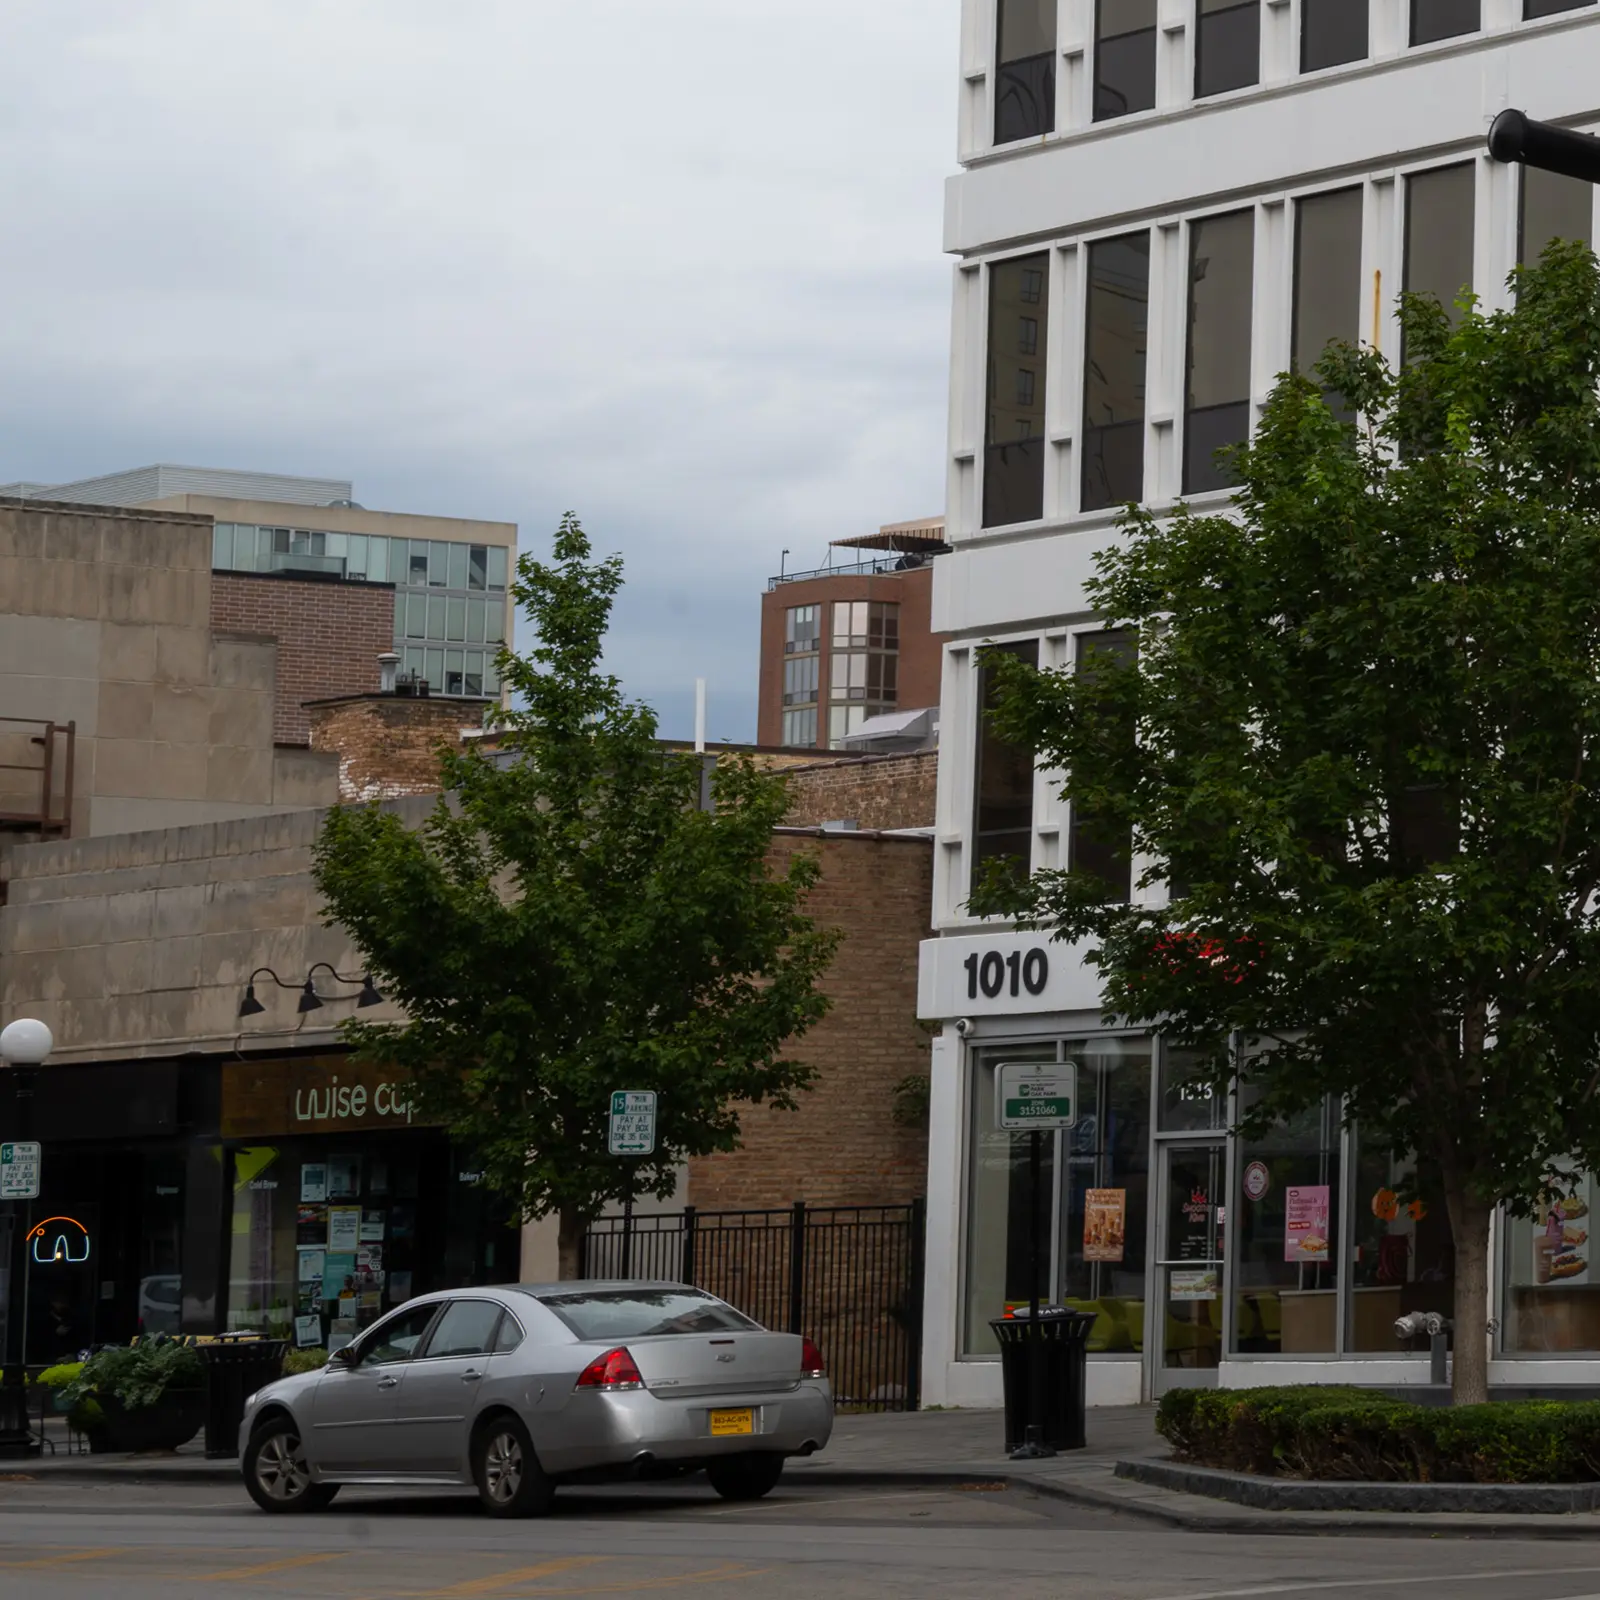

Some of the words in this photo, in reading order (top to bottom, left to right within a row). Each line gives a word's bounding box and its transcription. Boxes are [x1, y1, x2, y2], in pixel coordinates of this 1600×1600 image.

[964, 948, 1049, 999] 1010
[614, 1097, 625, 1111] 15
[626, 1104, 653, 1113] PARKING
[1019, 1105, 1057, 1116] 3151060
[620, 1115, 635, 1124] PAY
[638, 1115, 648, 1124] AT
[616, 1124, 632, 1133] PAY
[635, 1124, 650, 1133] BOX
[2, 1148, 13, 1160] 15
